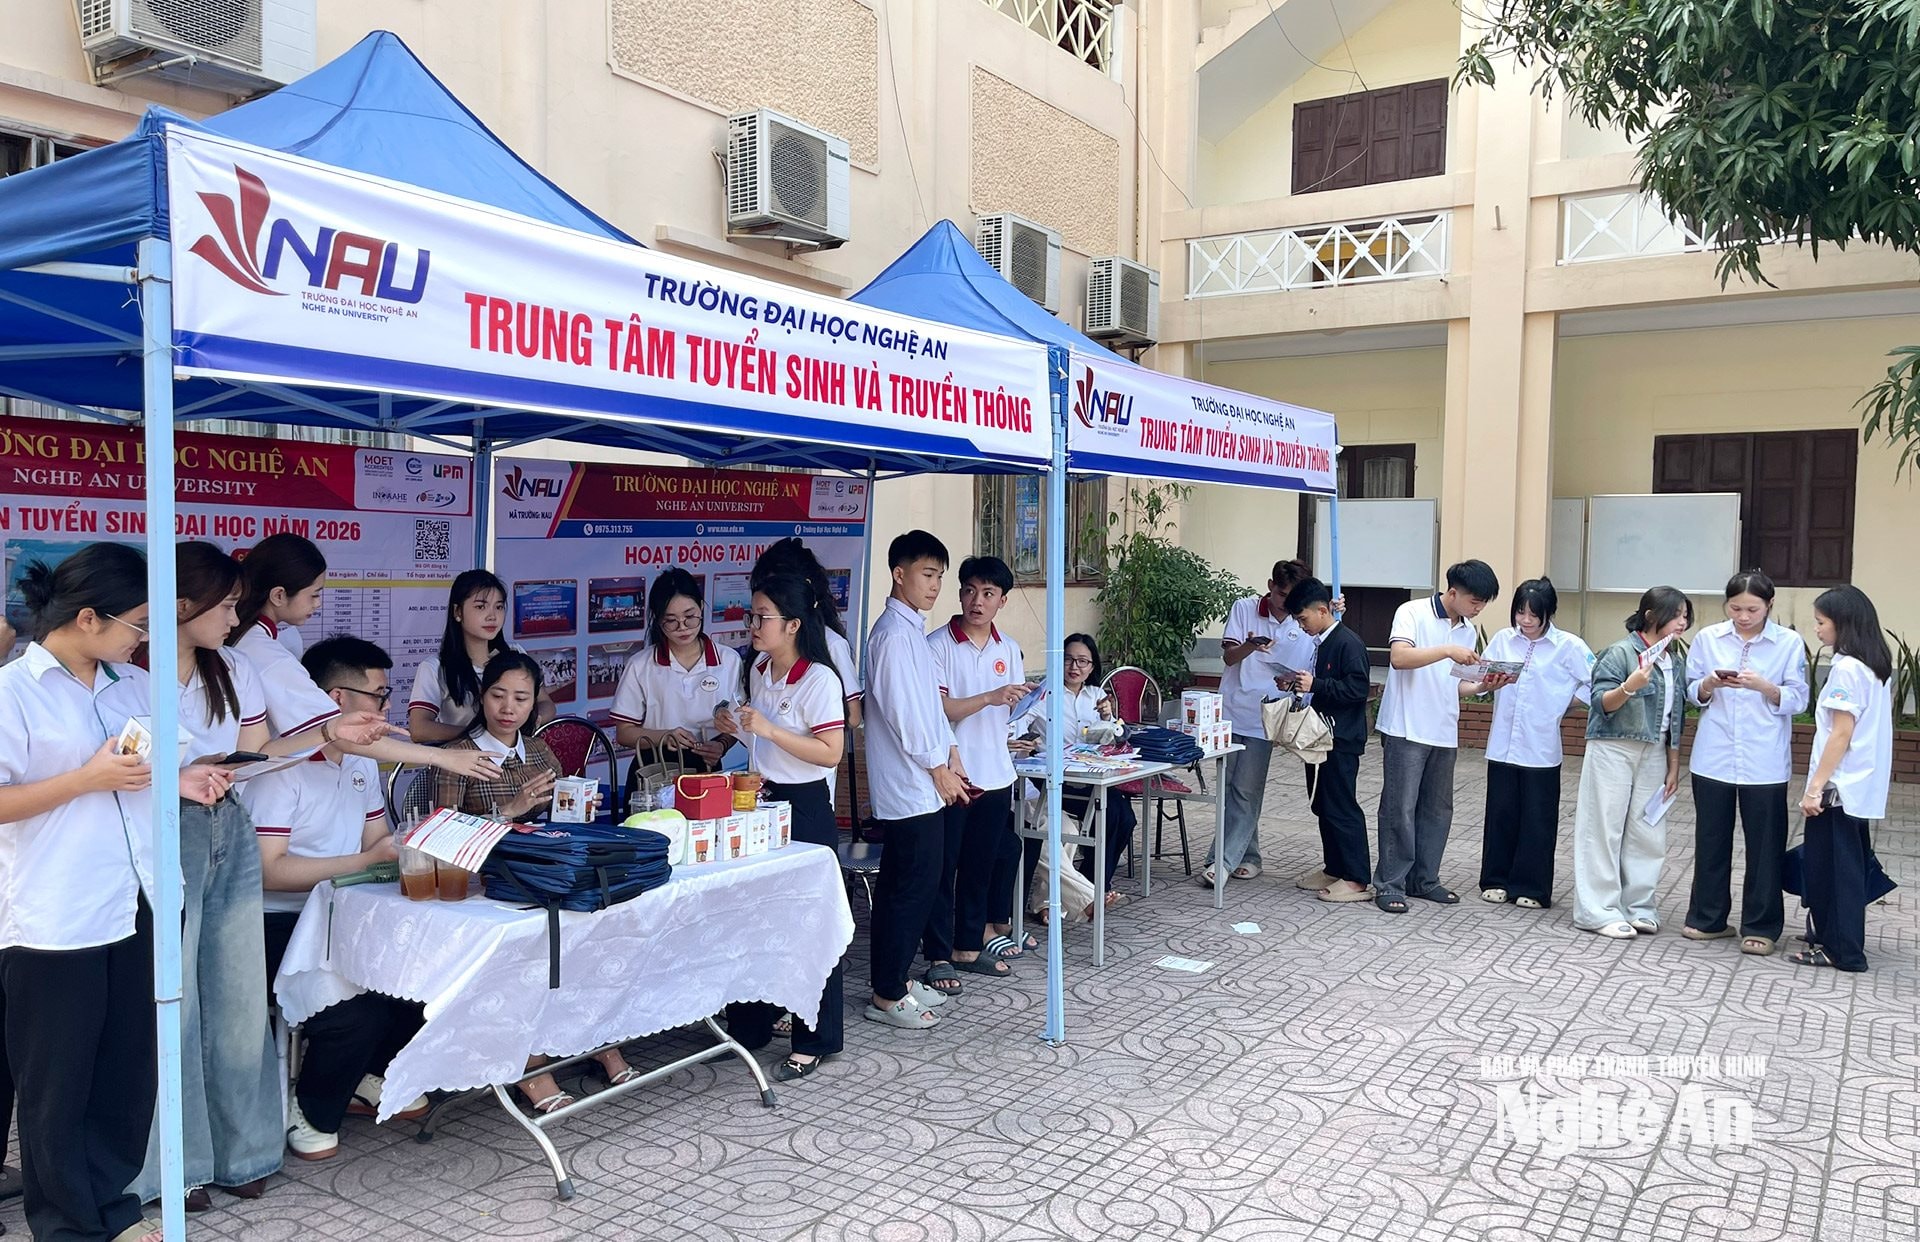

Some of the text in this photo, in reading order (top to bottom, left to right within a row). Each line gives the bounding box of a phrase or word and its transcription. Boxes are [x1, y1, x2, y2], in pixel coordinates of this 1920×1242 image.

[262, 218, 431, 305] NAU
[301, 302, 389, 323] NGHE AN UNIVERSITY
[406, 310, 418, 319] AN
[645, 272, 949, 361] TRƯỜNG ĐẠI HỌC NGHỆ AN
[464, 291, 1033, 434] TRUNG TÂM TUYỂN SINH VÀ TRUYỀN THÔNG
[1089, 390, 1134, 426] NAU
[1191, 395, 1296, 432] TRƯỜNG ĐẠI HỌC NGHỆ AN
[69, 437, 126, 468] ĐẠI
[135, 442, 200, 469] HC
[208, 446, 286, 480] NGHỆ
[293, 455, 330, 477] AN
[1139, 416, 1330, 473] TRUNG TÂM TUYỂN SINH VÀ TRUYỀN THÔNG
[364, 455, 394, 466] MOET
[432, 463, 464, 480] UPM
[13, 468, 257, 496] NGHE AN UVERSITY
[519, 478, 564, 498] NAU
[612, 471, 799, 501] TRƯỜNG ĐẠI HỌC NGHỆ AN
[18, 500, 97, 532] TUYỂN
[105, 510, 147, 534] SIN
[214, 516, 256, 541] HỌC
[263, 514, 310, 538] NĂM
[315, 520, 361, 541] 2026
[656, 500, 765, 513] NGHE AN UNIVERSITY
[594, 525, 633, 534] 0975.313.755
[625, 546, 674, 569] HOẠT
[677, 540, 725, 568] ĐỘNG
[729, 544, 750, 566] TẠI
